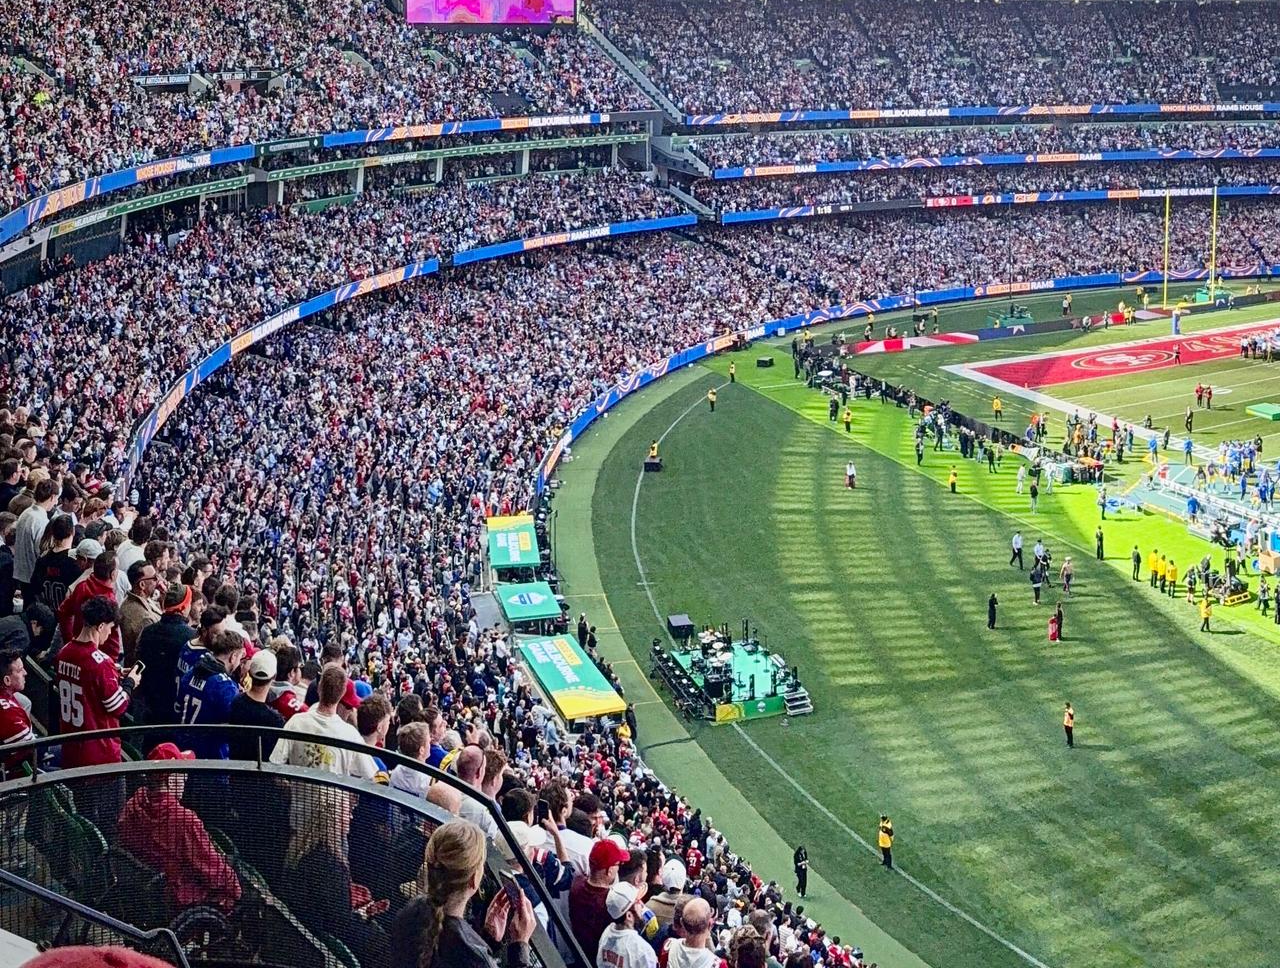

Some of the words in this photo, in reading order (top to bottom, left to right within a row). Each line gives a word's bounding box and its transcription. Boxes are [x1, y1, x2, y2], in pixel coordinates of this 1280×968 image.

[880, 109, 927, 118] MELBOURNE
[927, 108, 949, 117] GAME
[529, 116, 569, 127] MELBOURNE
[570, 114, 590, 124] GAME
[1079, 153, 1102, 161] RAMS
[795, 164, 817, 173] RAMS
[1139, 188, 1188, 197] MELBOURNE
[571, 230, 589, 242] RAMS
[590, 226, 610, 239] HOUSE
[1031, 281, 1054, 290] RAMS
[58, 660, 82, 680] KITTLE
[59, 679, 84, 728] 85
